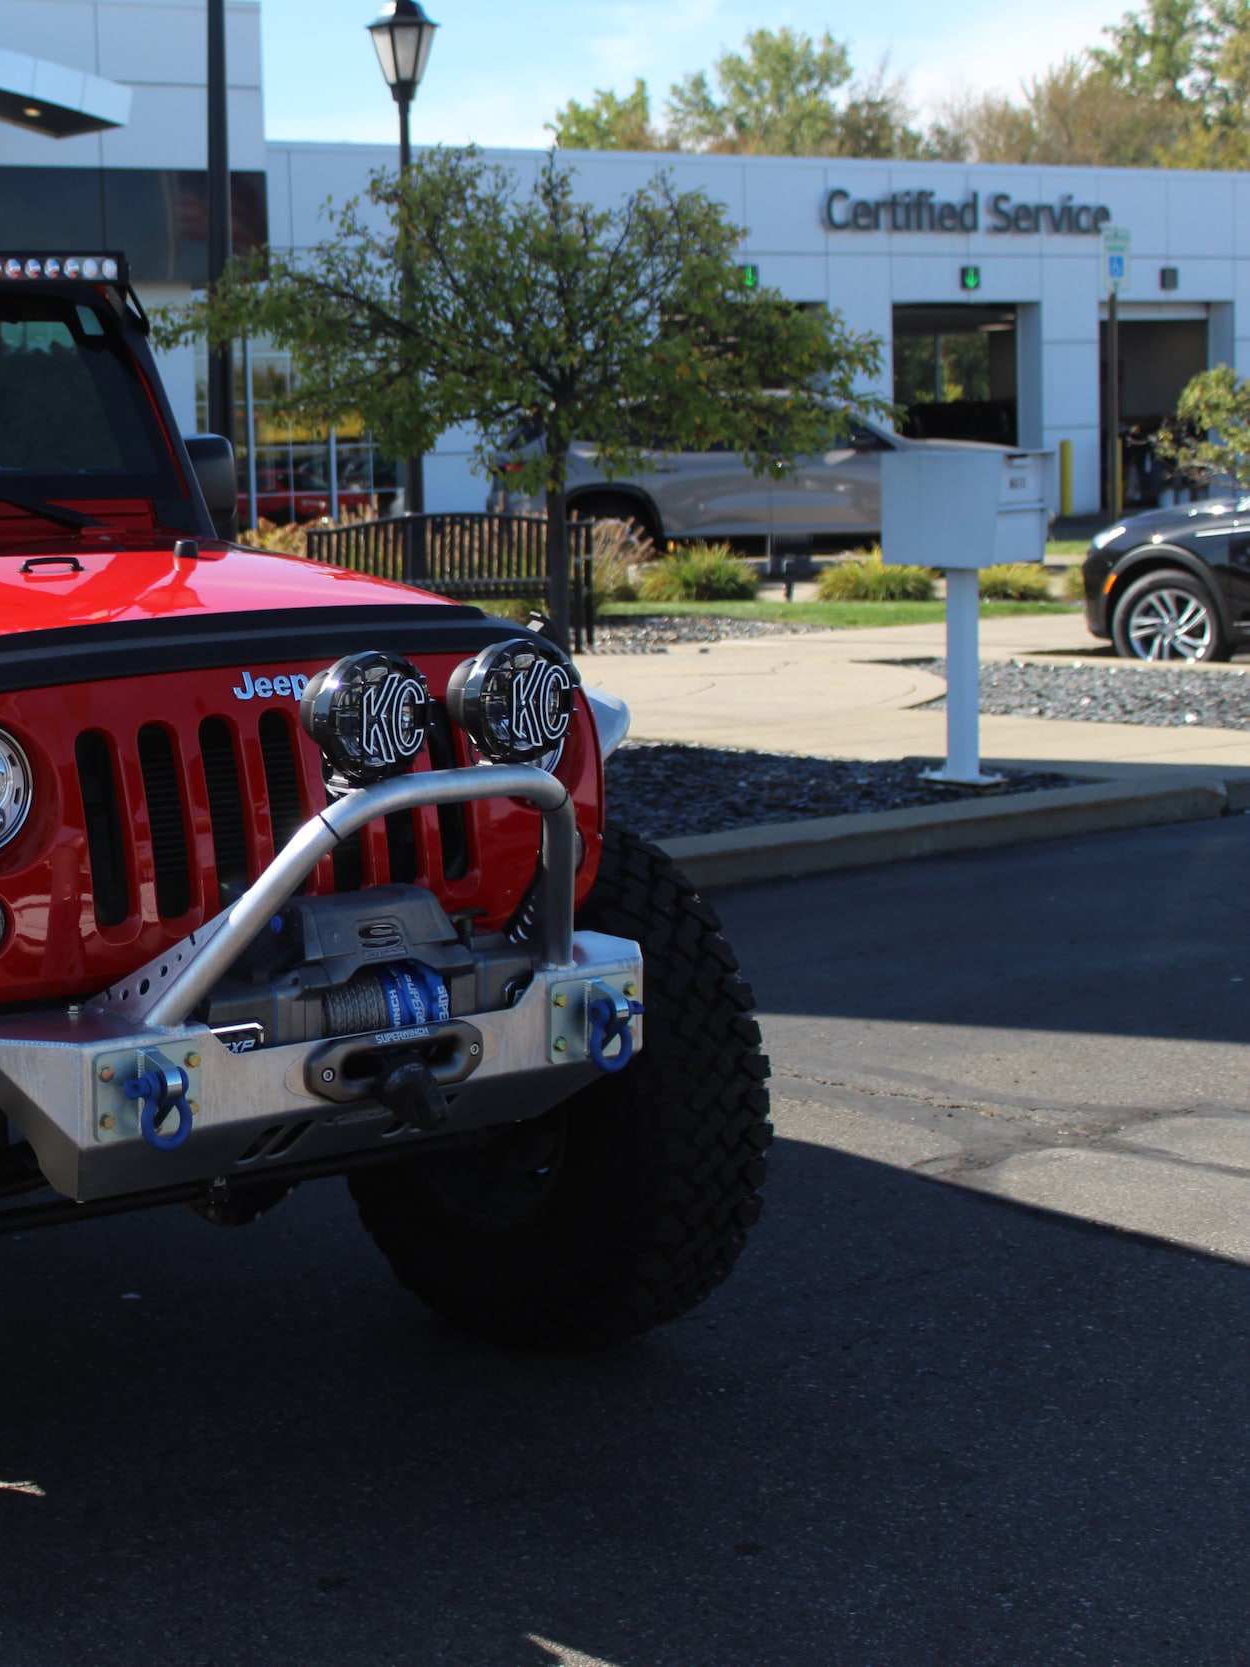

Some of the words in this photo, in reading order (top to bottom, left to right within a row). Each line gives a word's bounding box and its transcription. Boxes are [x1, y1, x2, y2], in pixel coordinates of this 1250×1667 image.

[824, 189, 980, 233] Certified
[990, 193, 1112, 236] Service
[232, 671, 309, 701] Jeep
[512, 659, 570, 747] KC
[362, 673, 425, 763] KC
[374, 1026, 430, 1045] SUPERWINCH
